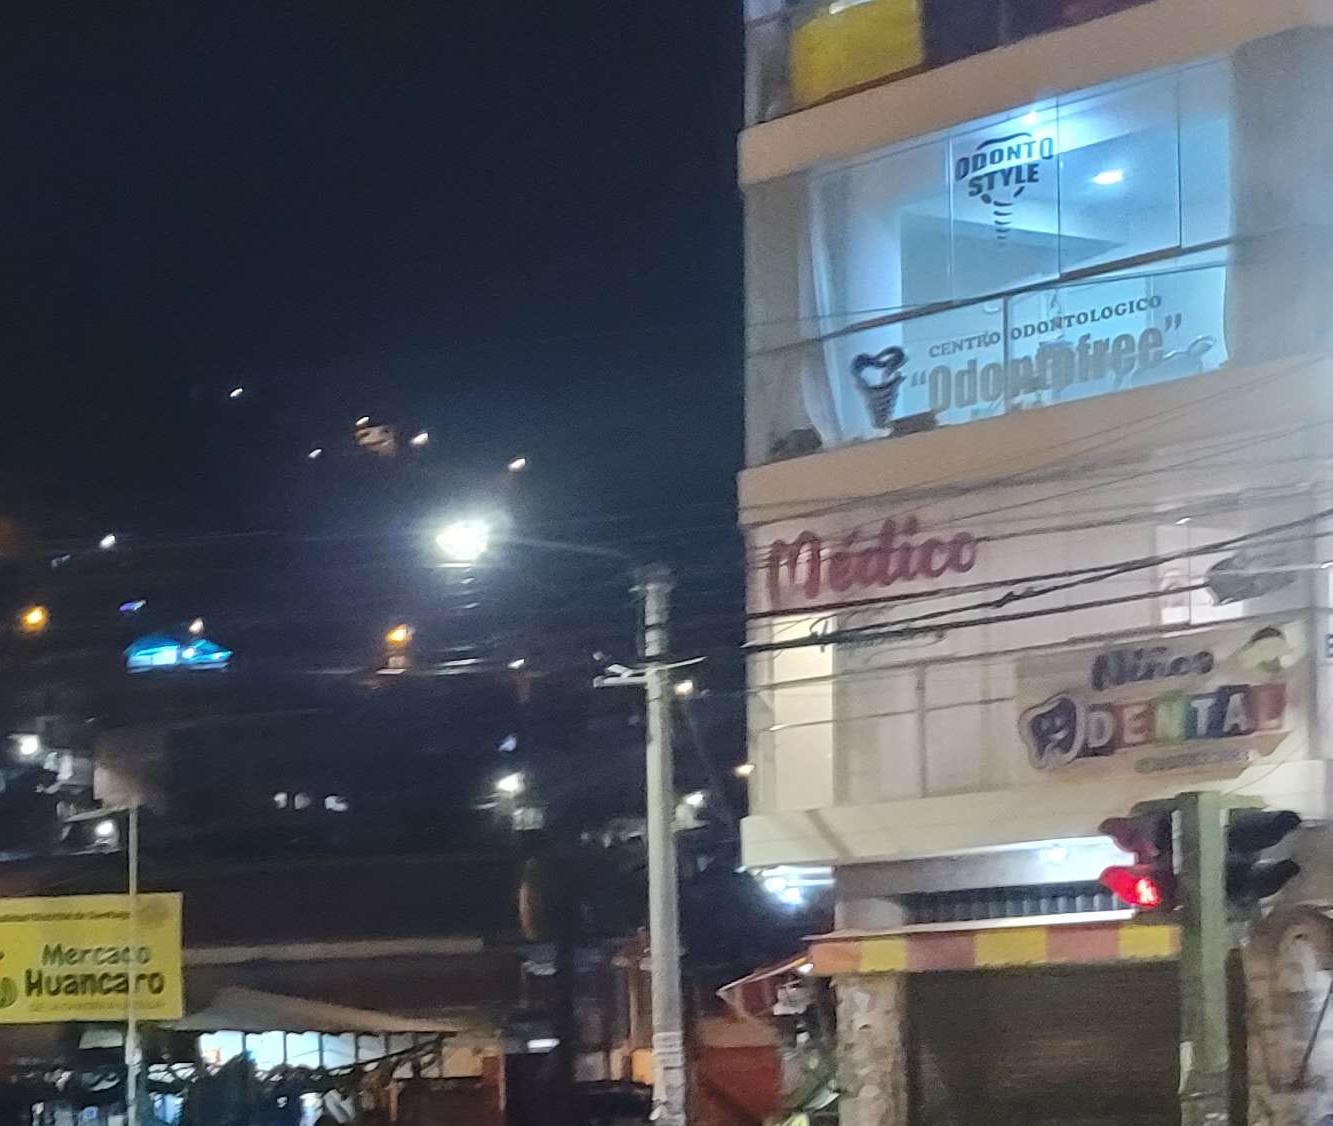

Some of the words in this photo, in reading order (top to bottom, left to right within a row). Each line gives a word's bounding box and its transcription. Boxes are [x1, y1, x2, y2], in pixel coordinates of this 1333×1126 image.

[954, 137, 1054, 181] ODONTO
[967, 163, 1040, 197] STYLE
[929, 330, 1001, 358] CENTRO
[1010, 296, 1162, 340] ODONTOLOGICO
[25, 968, 165, 997] Huancaro
